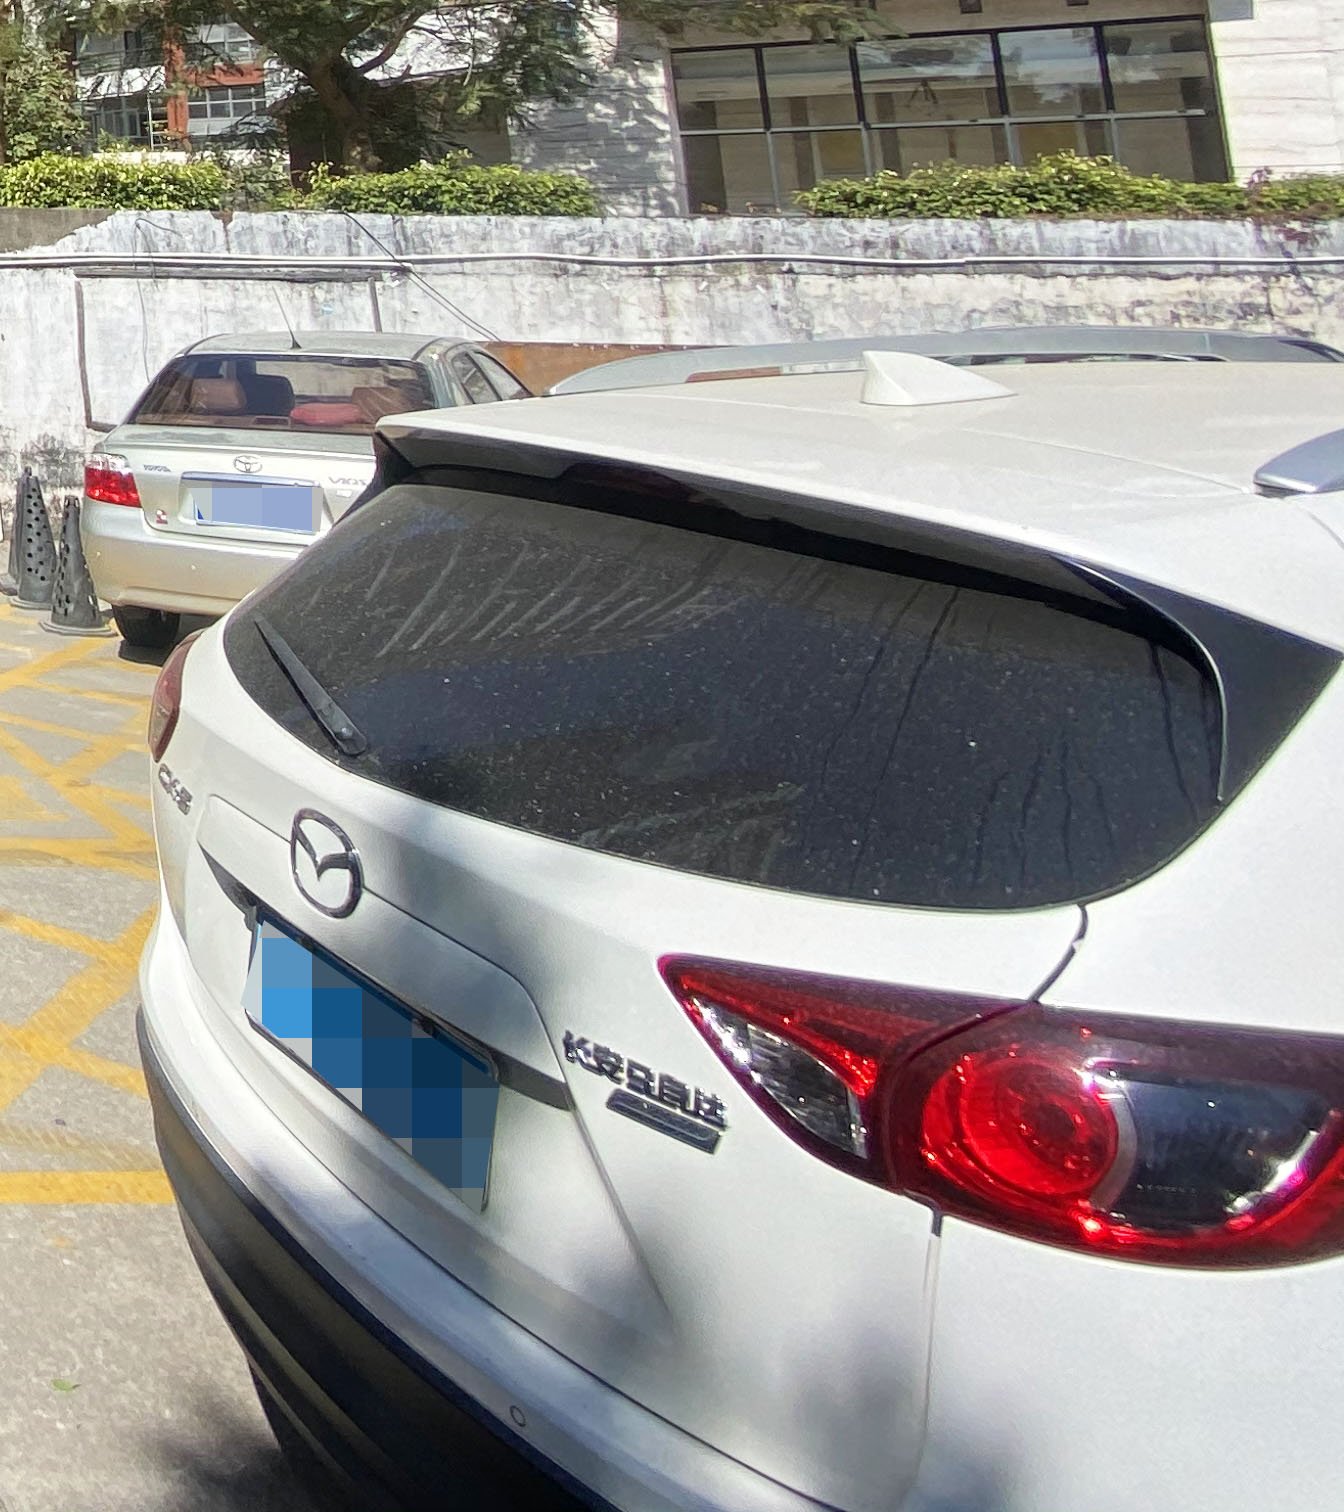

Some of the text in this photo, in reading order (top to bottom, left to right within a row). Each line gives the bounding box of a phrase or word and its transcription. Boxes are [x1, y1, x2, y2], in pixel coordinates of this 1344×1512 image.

[562, 1029, 730, 1131] 长安马自达
